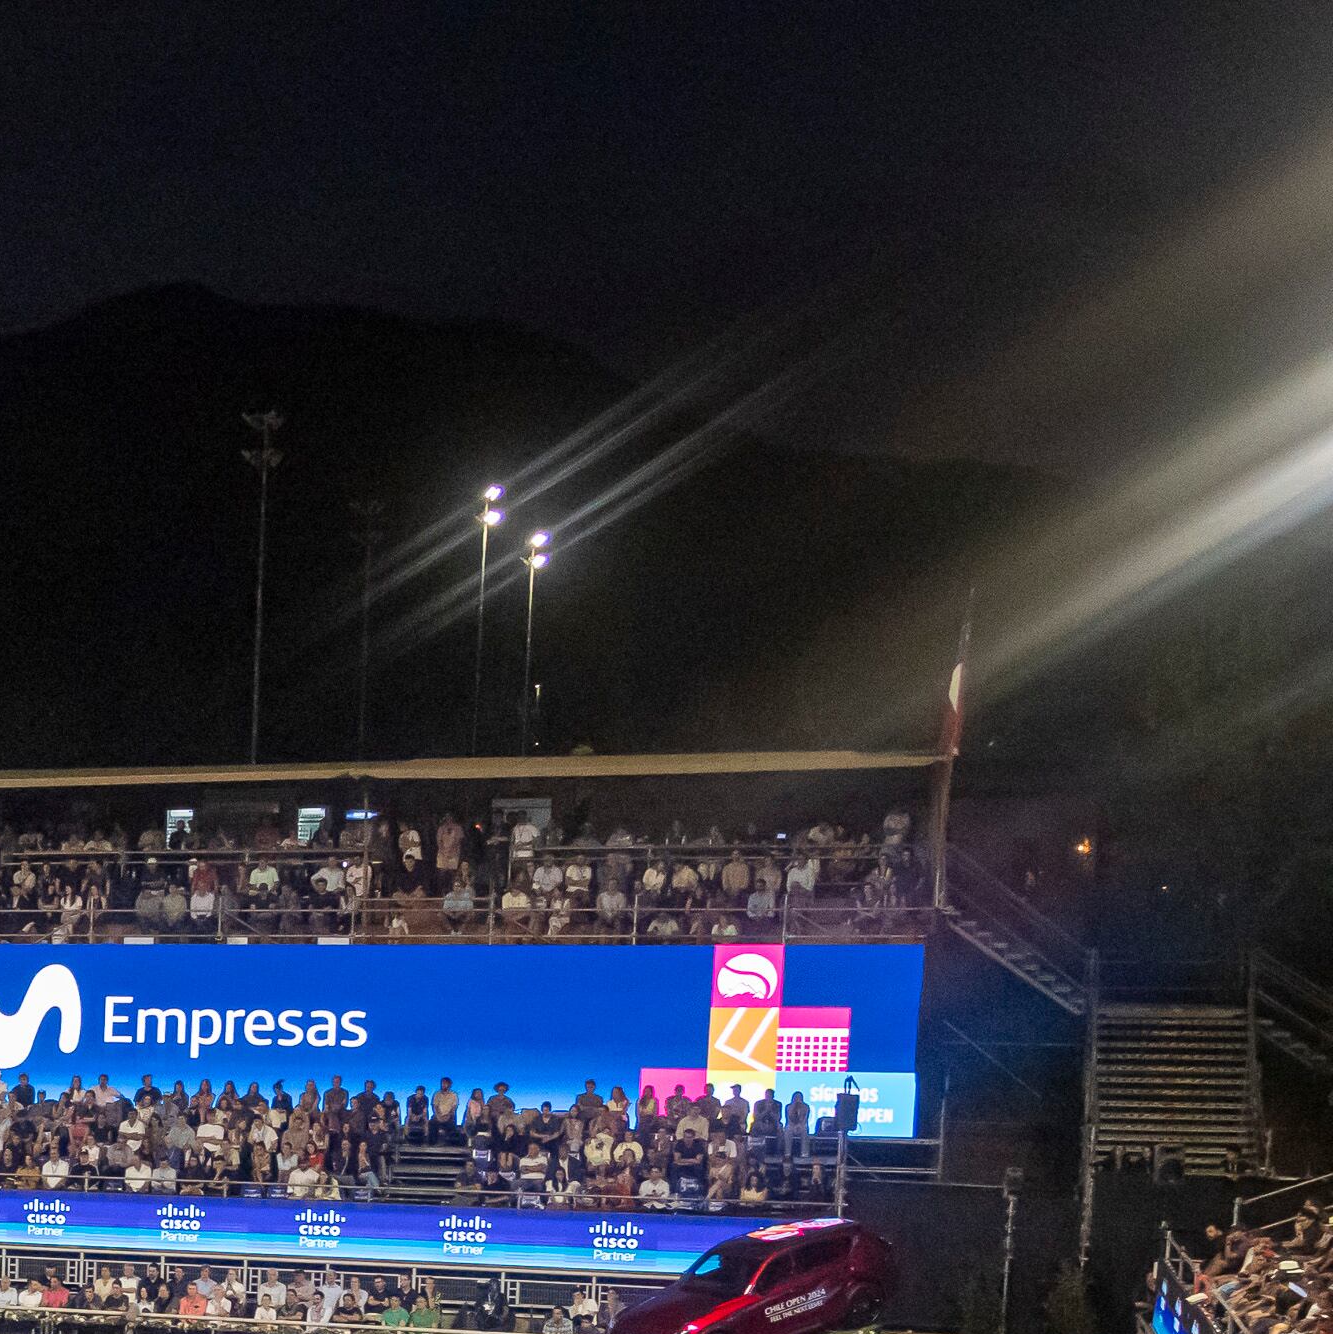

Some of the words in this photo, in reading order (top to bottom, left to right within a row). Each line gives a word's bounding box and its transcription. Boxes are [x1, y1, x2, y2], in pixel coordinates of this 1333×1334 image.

[103, 996, 368, 1059] Empresas
[27, 1214, 66, 1225] CISCO
[160, 1219, 201, 1230] CISCO
[27, 1225, 65, 1237] Partner
[160, 1230, 200, 1243] Partner
[299, 1225, 341, 1236] CISCO
[299, 1236, 339, 1249] Partner
[443, 1231, 486, 1243] CISCO
[593, 1237, 639, 1249] CISCO
[443, 1243, 485, 1255] Partner
[593, 1249, 636, 1262] Partner
[765, 1302, 785, 1315] CHILE
[786, 1295, 806, 1307] OPEN
[807, 1288, 826, 1300] 2024
